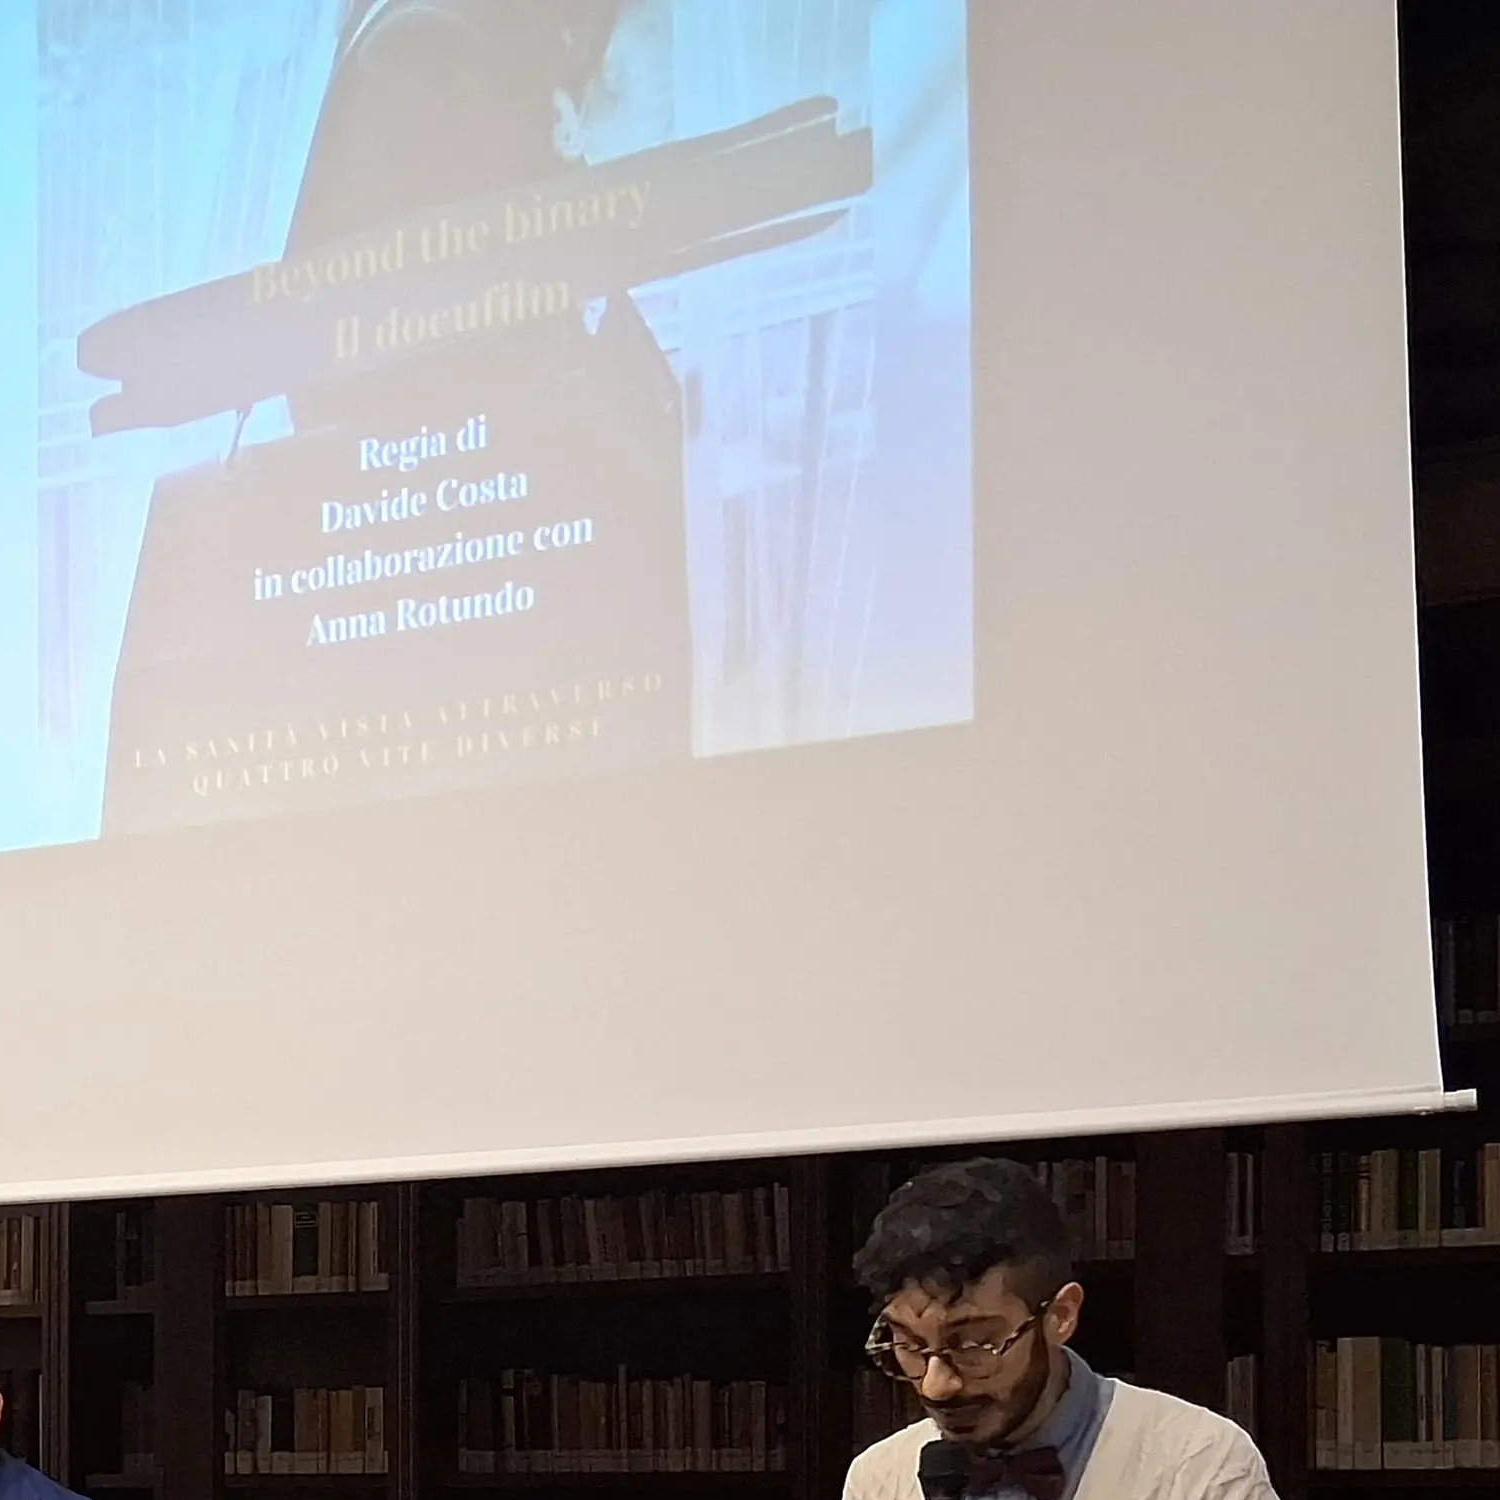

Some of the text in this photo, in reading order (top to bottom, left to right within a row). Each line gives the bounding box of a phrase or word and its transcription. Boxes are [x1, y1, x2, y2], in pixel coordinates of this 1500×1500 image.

[253, 179, 650, 304] Beyond the binary
[375, 280, 571, 352] docufilm
[359, 413, 487, 472] Regia di
[320, 471, 529, 535] Davide Costa
[253, 516, 594, 602] in collaborazione con
[305, 580, 536, 648] Anna Rotundo
[192, 714, 602, 798] QUATTRO VITE DIVERSE
